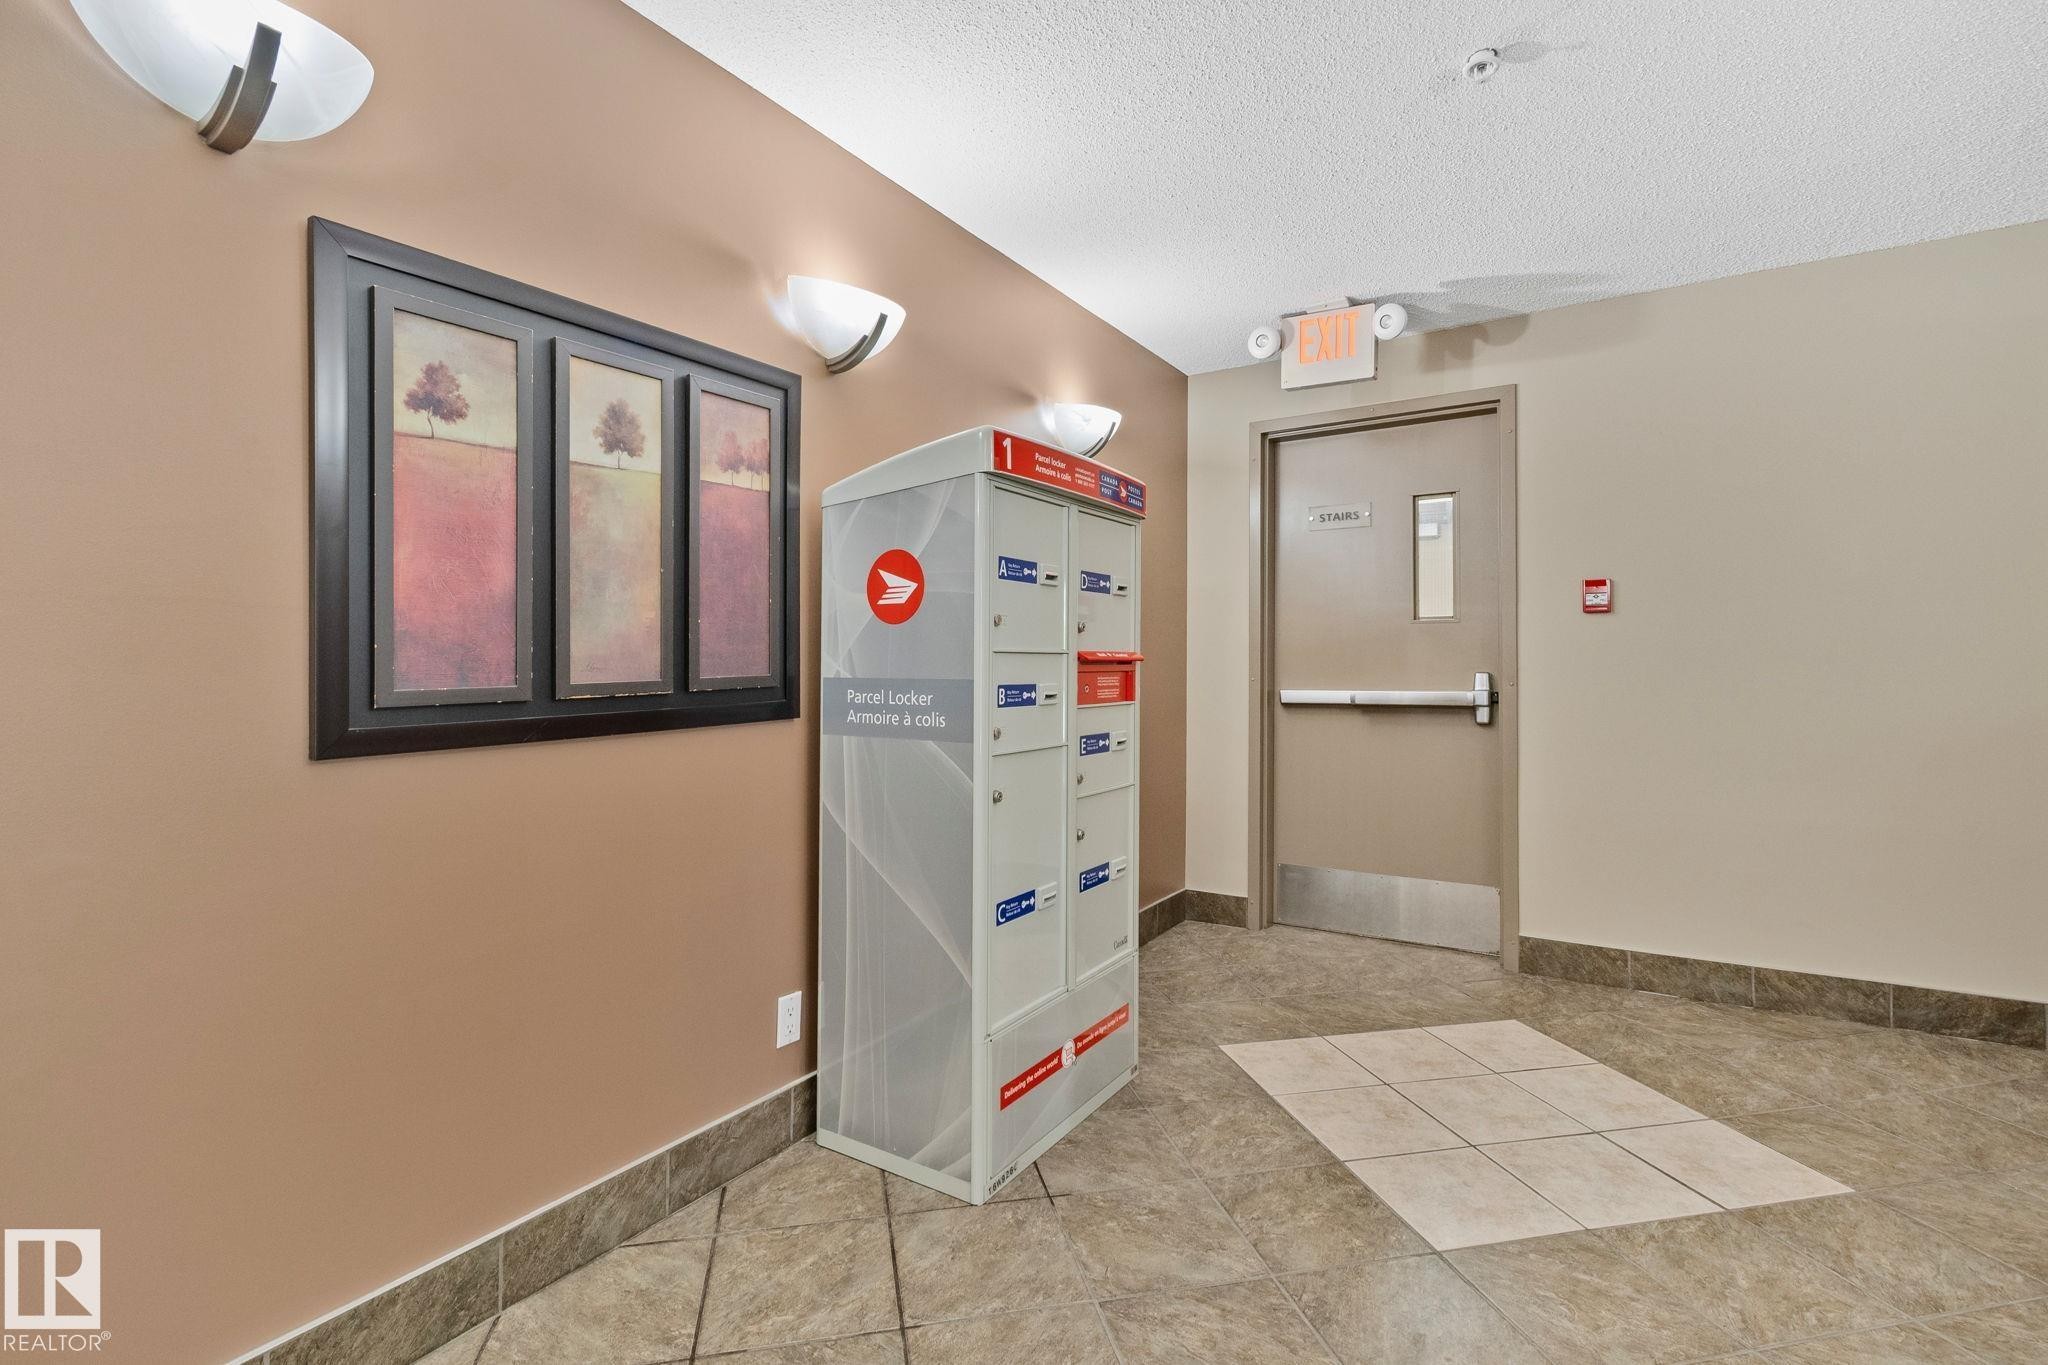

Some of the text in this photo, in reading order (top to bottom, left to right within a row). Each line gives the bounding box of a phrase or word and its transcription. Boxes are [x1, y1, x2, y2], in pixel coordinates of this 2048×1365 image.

[1299, 311, 1359, 364] EXIT
[1002, 437, 1012, 470] 1
[1035, 452, 1066, 469] Parcel locker
[1035, 464, 1056, 477] Armoire
[1060, 472, 1072, 482] colis
[1101, 475, 1118, 486] CANADA
[1101, 487, 1112, 496] POST
[1128, 497, 1143, 507] CANADA
[1319, 511, 1360, 523] STAIRS
[1000, 560, 1007, 577] A
[1081, 574, 1088, 589] D
[847, 689, 934, 706] Parcel Locker
[999, 688, 1006, 705] B
[846, 709, 946, 728] Armoire à colis
[1081, 739, 1087, 754] E
[1081, 873, 1087, 891] F
[998, 904, 1006, 923] C
[1004, 1080, 1027, 1100] Delivering
[1026, 1074, 1034, 1084] the
[1033, 1066, 1047, 1079] online
